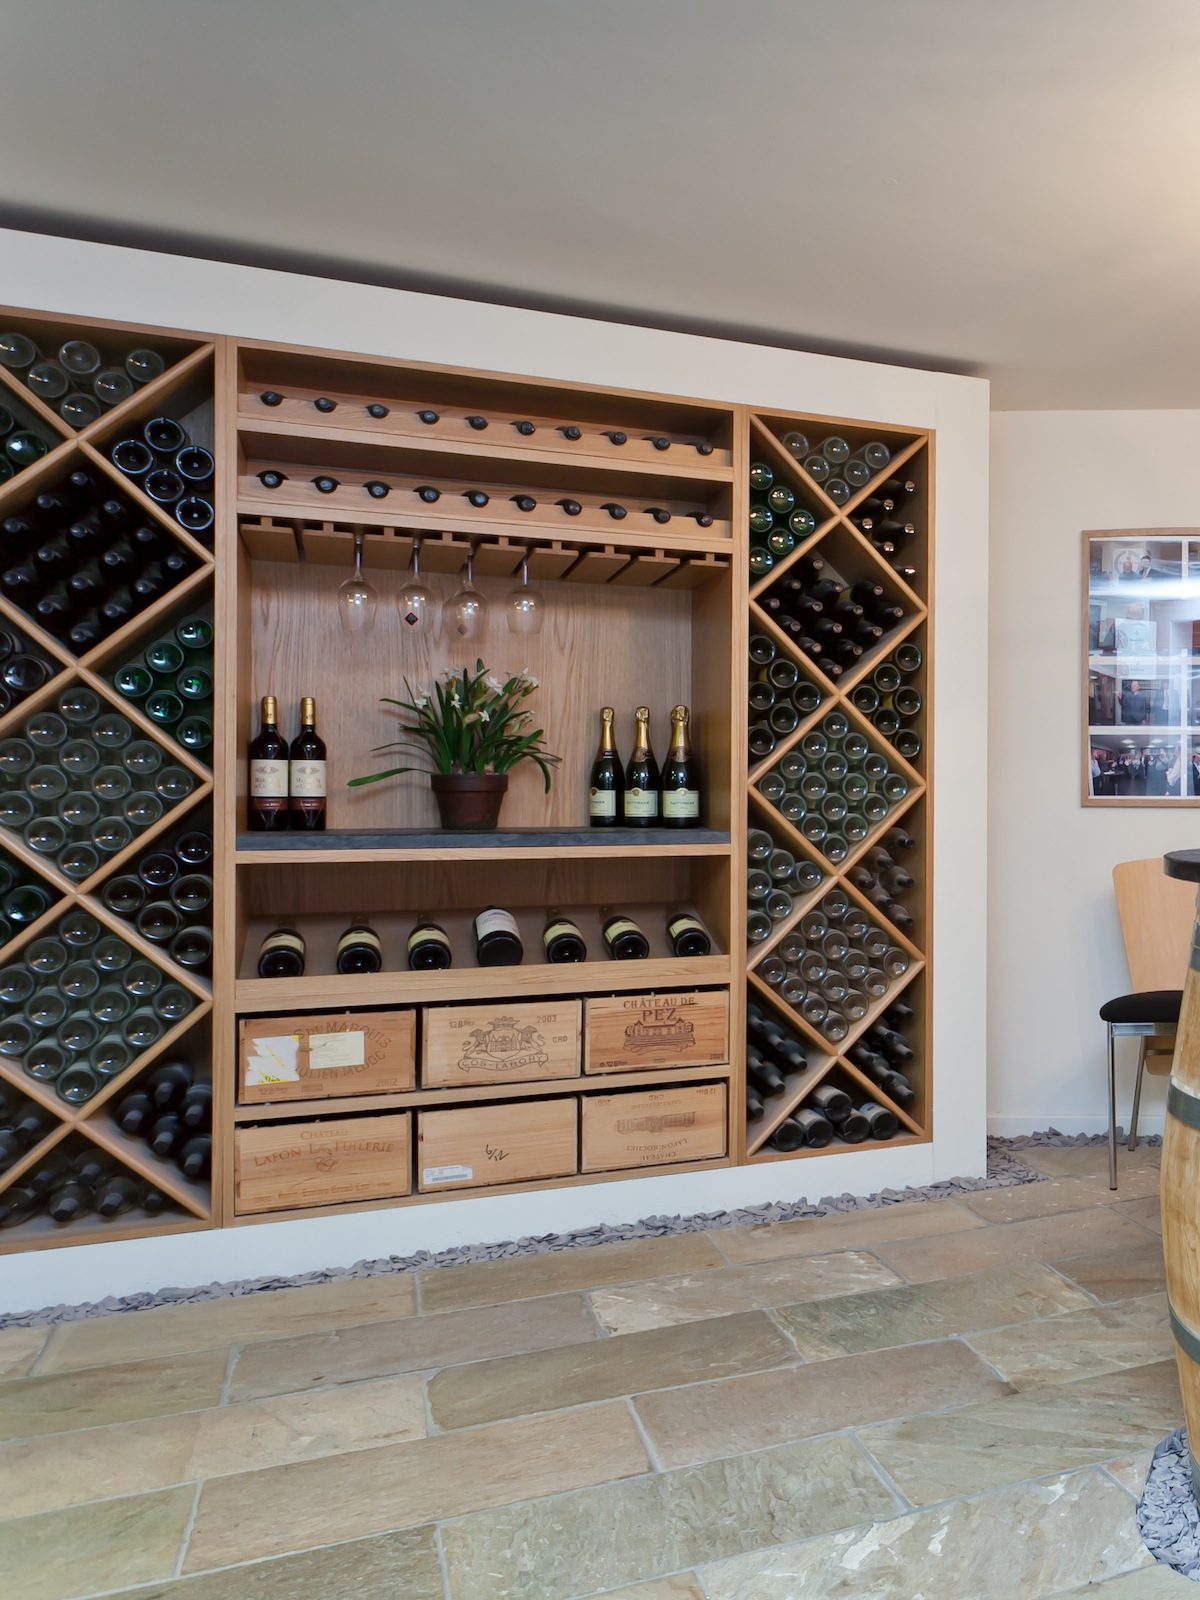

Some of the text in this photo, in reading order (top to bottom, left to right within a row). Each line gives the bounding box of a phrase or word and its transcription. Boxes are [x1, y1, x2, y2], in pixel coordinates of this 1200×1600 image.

[623, 996, 695, 1009] CHÂTEAU DE
[536, 1014, 557, 1024] 2003
[642, 1008, 677, 1022] PEZ
[253, 1148, 302, 1167] LAFON
[309, 1143, 326, 1155] LA
